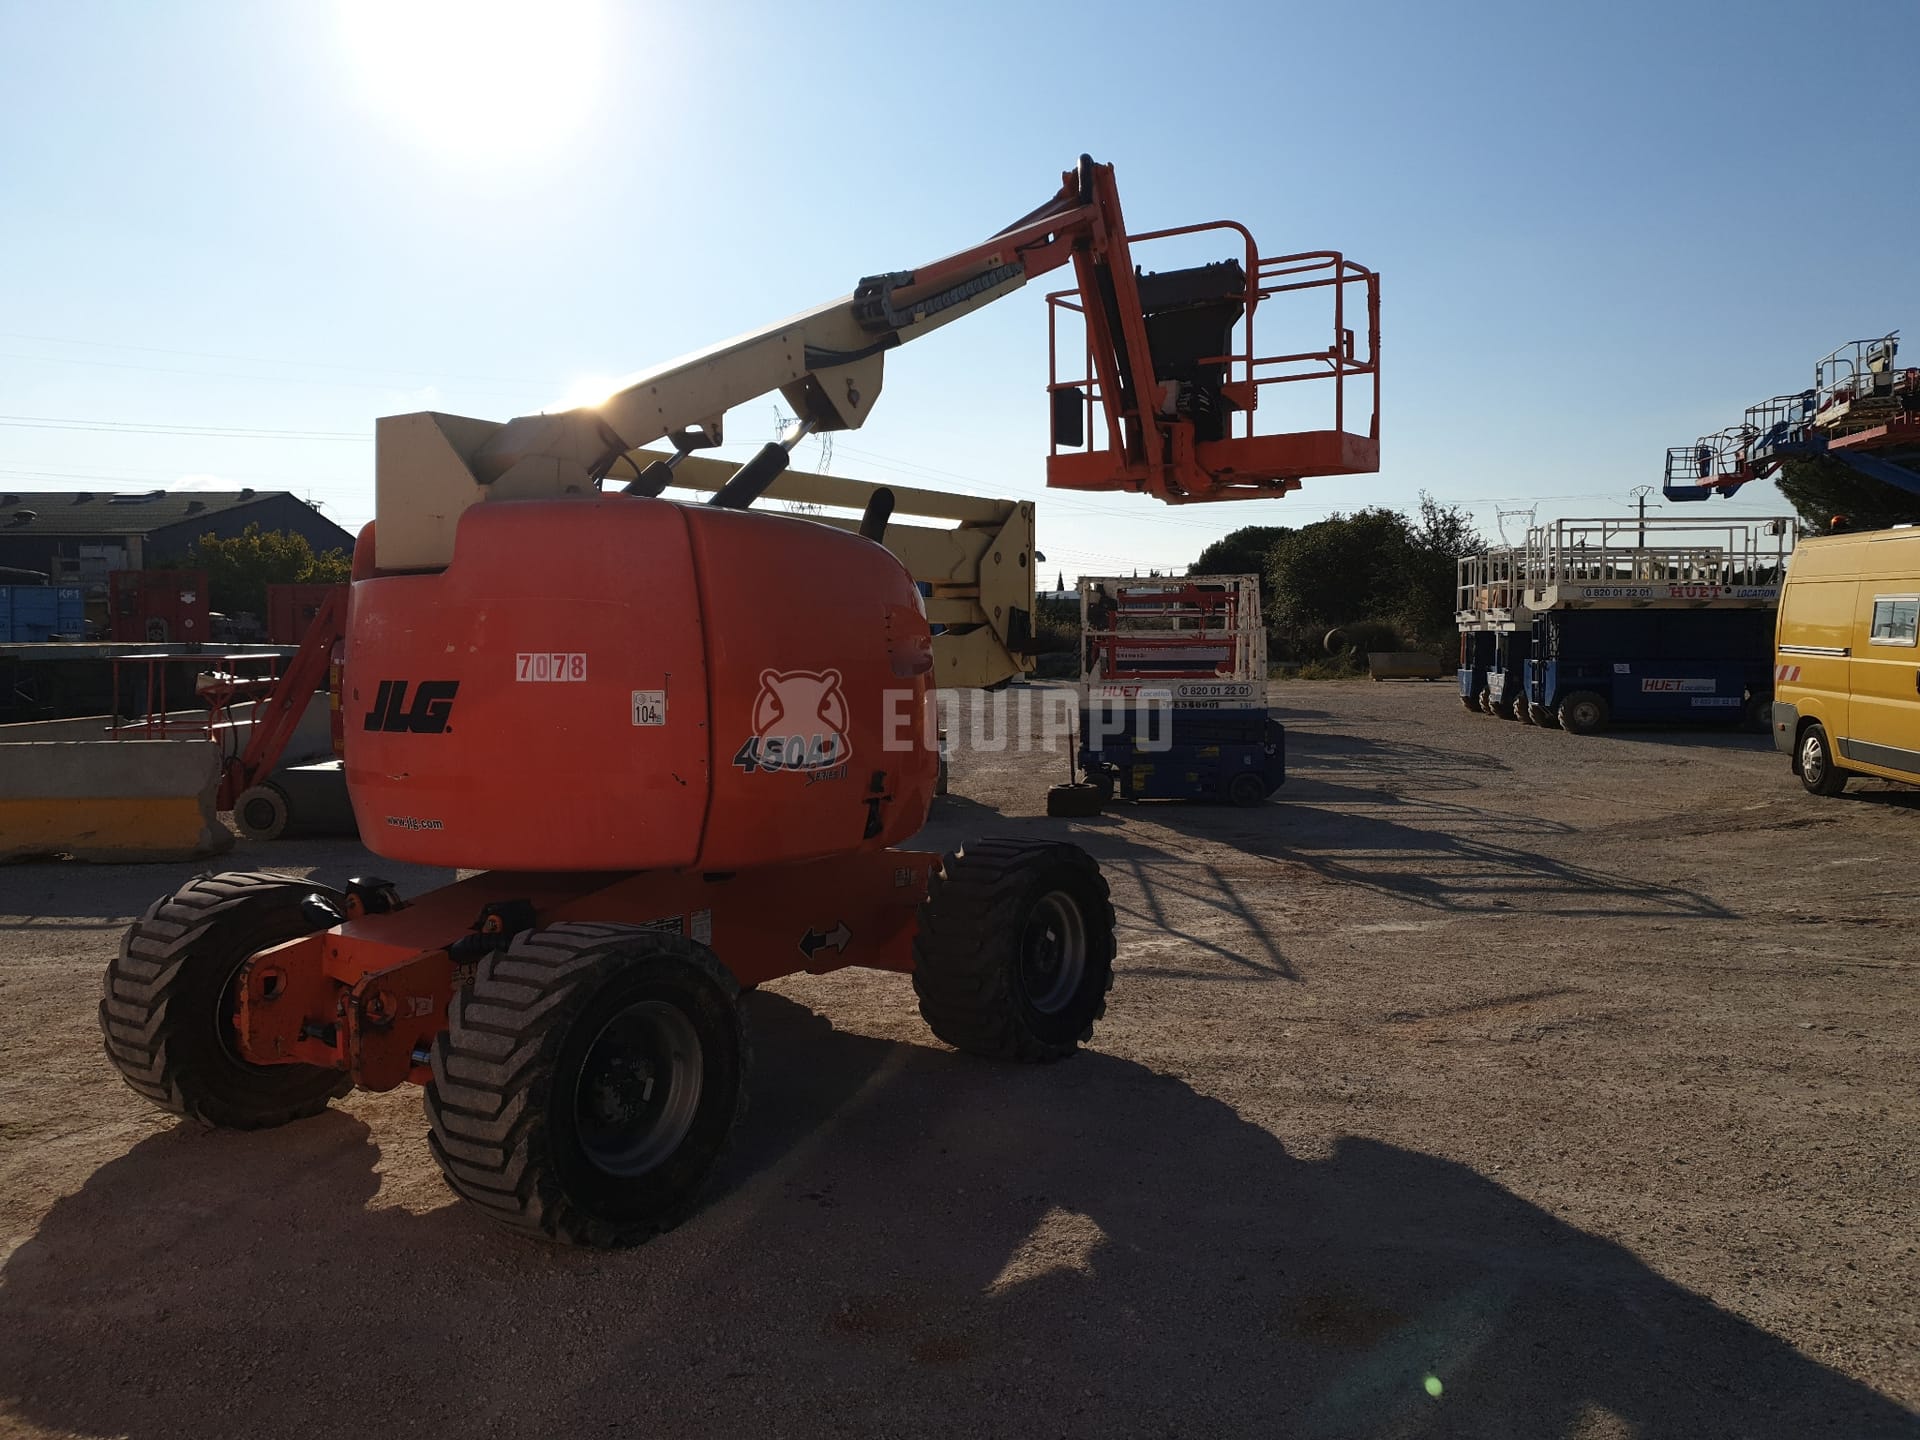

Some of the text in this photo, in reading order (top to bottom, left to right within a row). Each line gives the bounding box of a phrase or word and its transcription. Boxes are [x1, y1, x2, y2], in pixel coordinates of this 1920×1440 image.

[1594, 589, 1610, 597] 820
[1612, 589, 1623, 597] 01
[1626, 589, 1638, 597] 22
[1639, 589, 1649, 597] 01
[1669, 586, 1777, 598] HUET LOCATION
[518, 655, 584, 679] 7078
[1102, 685, 1143, 697] HUET
[1182, 686, 1249, 695] 0 820 01 22 01
[1644, 680, 1684, 691] HUET
[635, 705, 657, 723] 104
[732, 733, 840, 773] 450AJ
[386, 815, 443, 830] www.jlg.com
